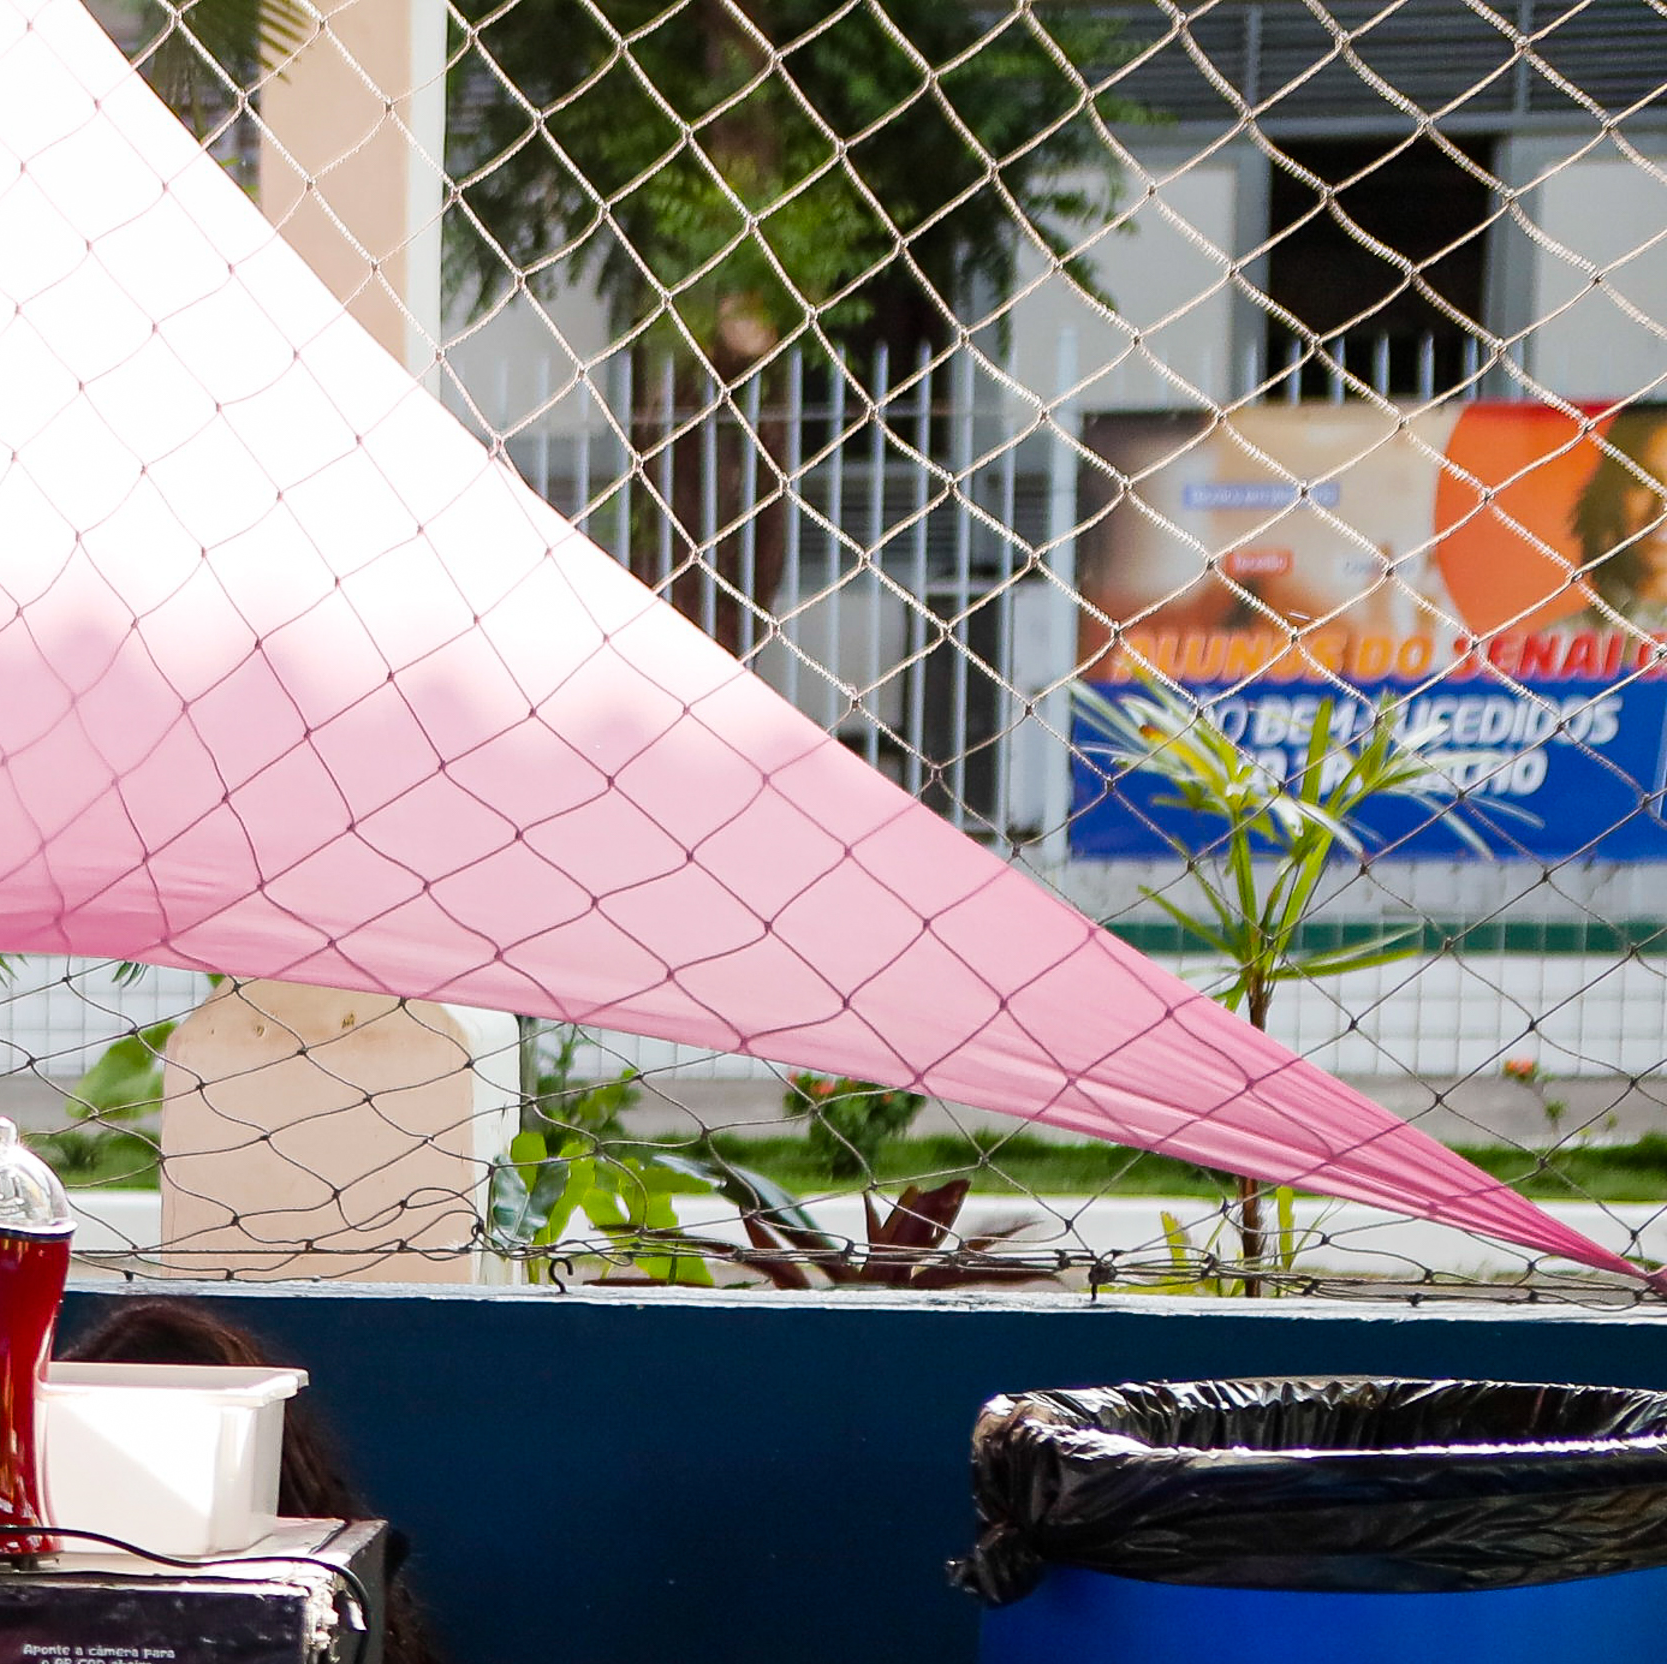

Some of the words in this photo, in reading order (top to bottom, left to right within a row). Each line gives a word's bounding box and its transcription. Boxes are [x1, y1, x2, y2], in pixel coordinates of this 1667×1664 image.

[1356, 634, 1435, 682] DO
[74, 1646, 83, 1655] a
[143, 1648, 176, 1660] para
